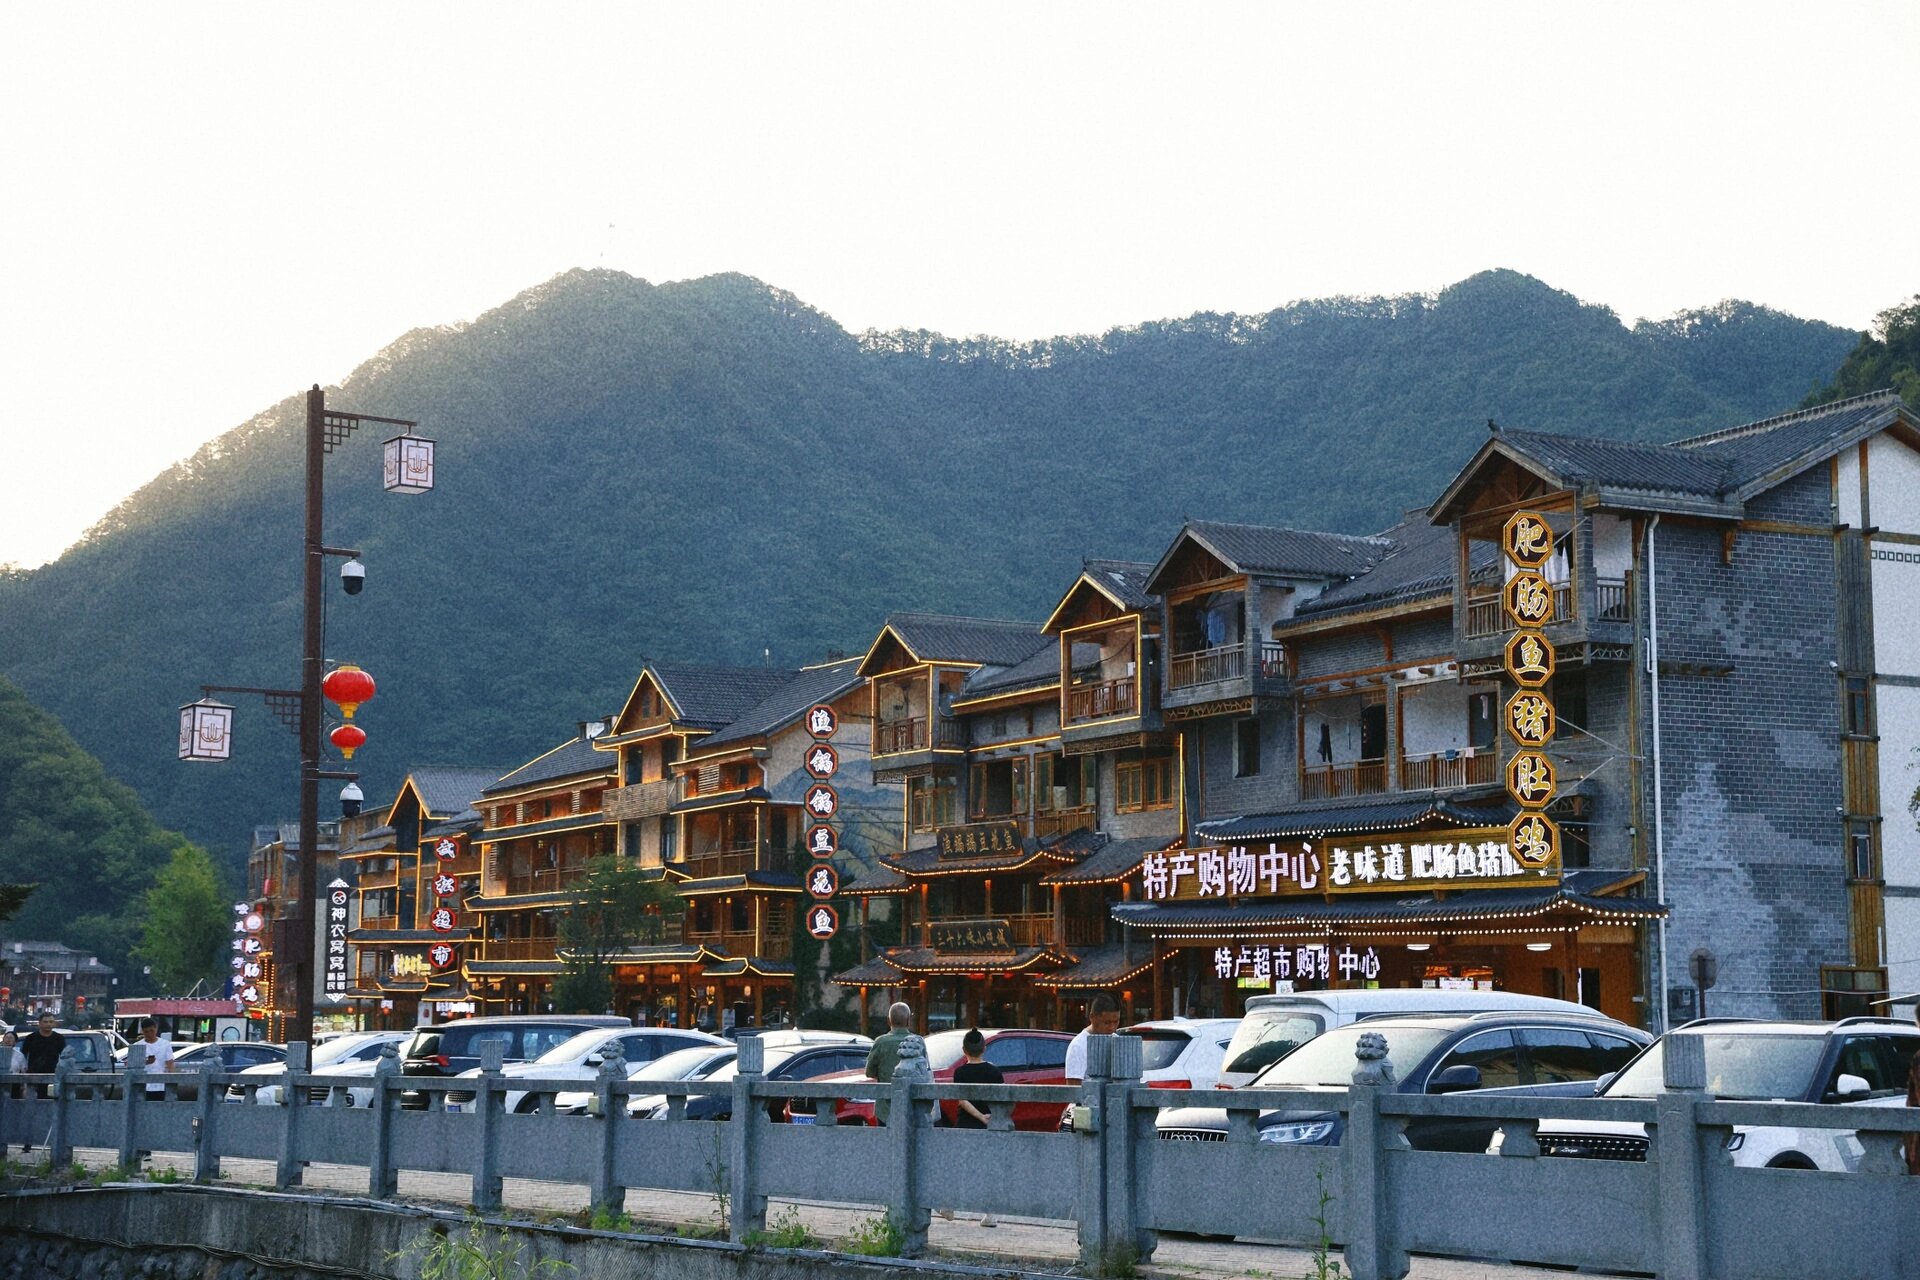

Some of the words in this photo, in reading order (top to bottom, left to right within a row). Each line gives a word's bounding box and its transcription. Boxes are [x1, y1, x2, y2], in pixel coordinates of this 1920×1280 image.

[1513, 517, 1551, 861] 肥肠鱼猪肚鸡
[1142, 842, 1322, 899] 特产购物中心
[329, 907, 346, 971] 神农窝窝
